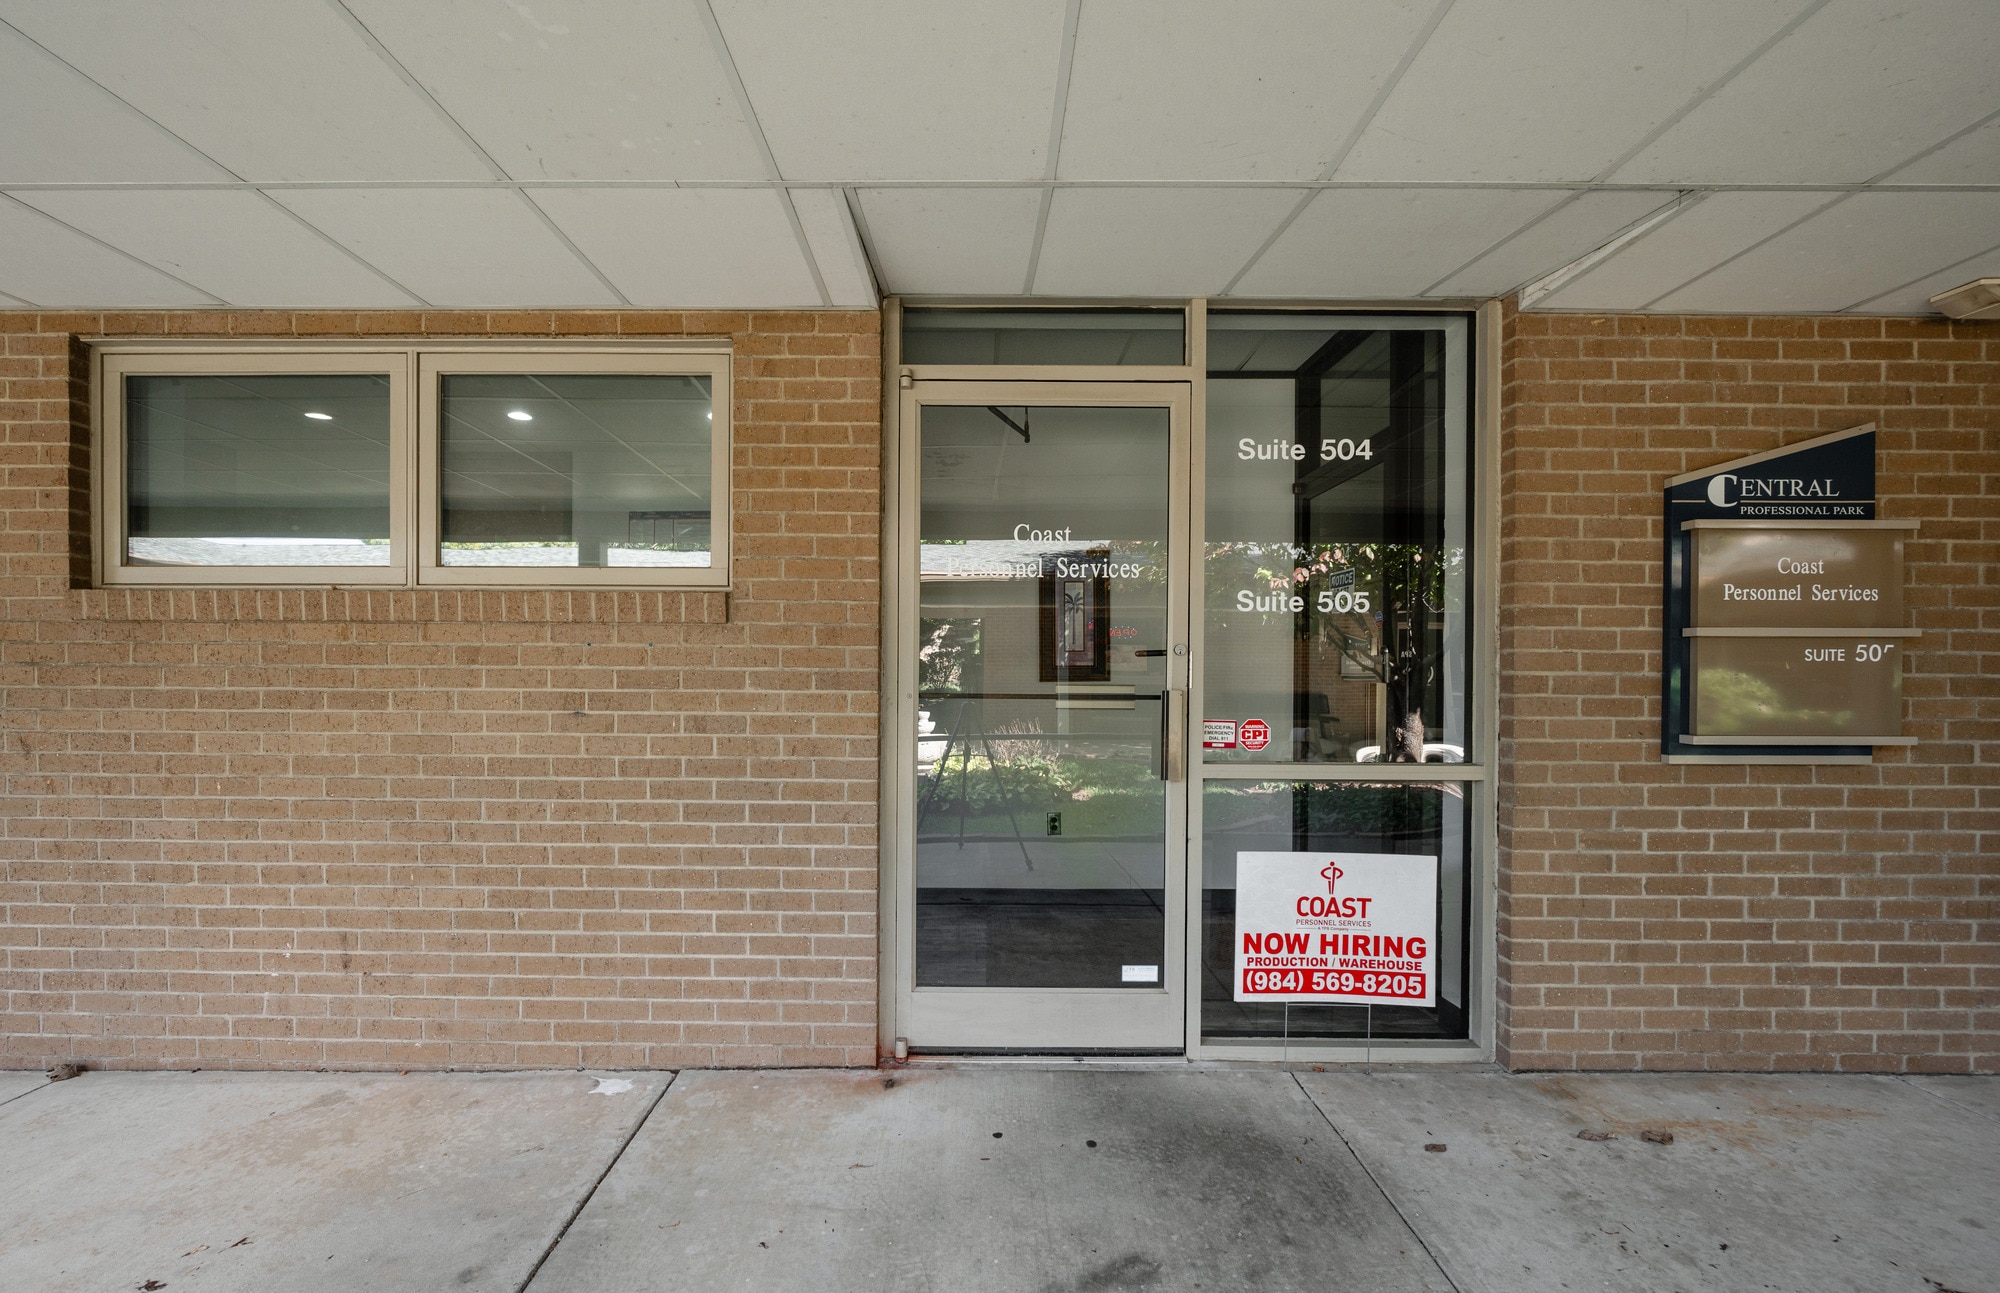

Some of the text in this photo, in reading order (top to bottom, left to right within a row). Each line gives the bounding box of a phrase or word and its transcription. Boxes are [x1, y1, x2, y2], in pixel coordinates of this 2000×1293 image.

[1237, 438, 1373, 461] Suite 504
[1707, 474, 1840, 508] CENTRAL
[1740, 506, 1865, 516] PROFESSIONAL PARK
[1013, 523, 1071, 544] Coast
[947, 557, 1140, 579] Personnel Services
[1777, 557, 1825, 575] Coast
[1331, 571, 1353, 588] NOTICE
[1236, 589, 1370, 614] Suite 505
[1723, 584, 1879, 602] Personnel Services
[1804, 648, 1846, 662] SUITE
[1241, 730, 1268, 740] CPI
[1296, 896, 1372, 918] COAST
[1295, 918, 1372, 928] PERSONNEL SERVICES
[1243, 932, 1427, 959] NOW HIRING
[1247, 957, 1328, 967] PRODUCTION
[1339, 958, 1422, 971] WAREHOUSE
[1246, 970, 1423, 995] (984) 569-8205
